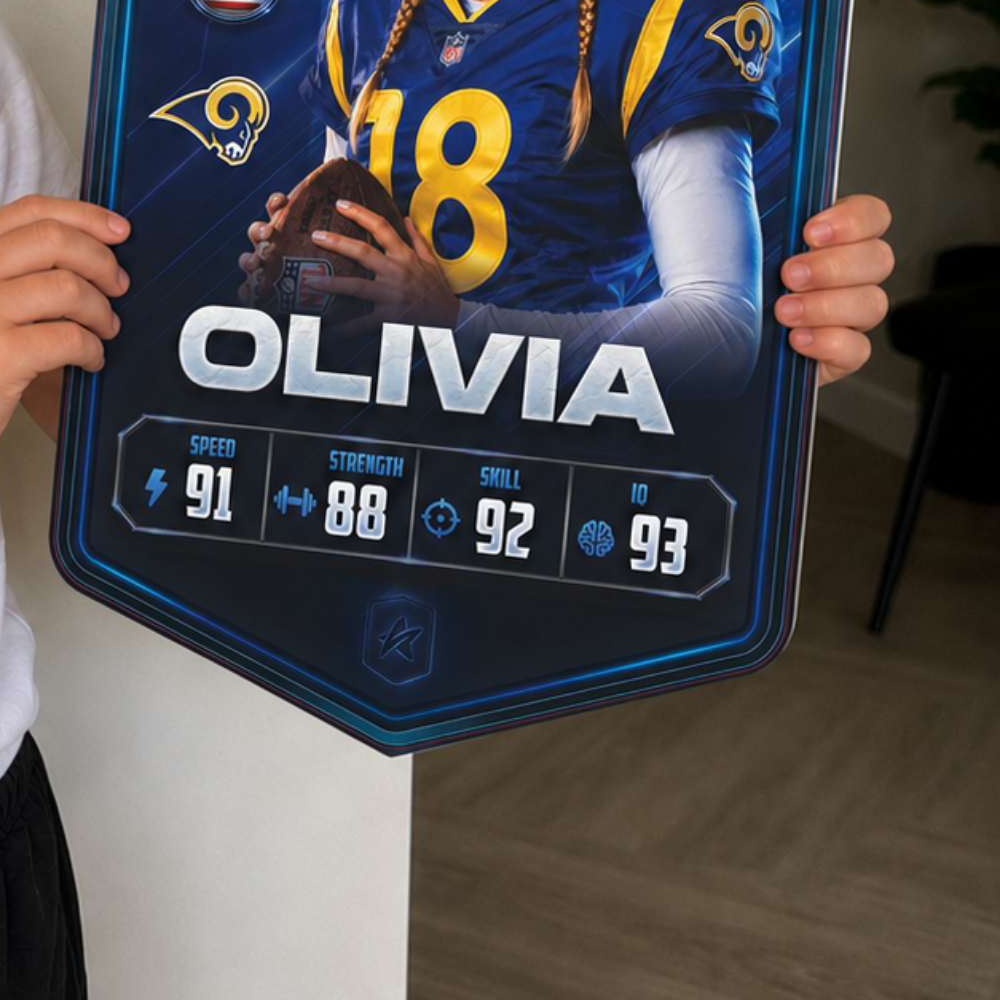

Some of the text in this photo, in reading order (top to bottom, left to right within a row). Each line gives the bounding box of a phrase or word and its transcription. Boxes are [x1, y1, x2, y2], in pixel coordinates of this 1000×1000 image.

[178, 305, 674, 435] OLIVIA
[190, 435, 236, 458] SPEED
[329, 450, 404, 477] STRENGTH
[186, 463, 233, 522] 91
[480, 466, 521, 490] SKILL
[631, 483, 648, 506] IQ
[324, 480, 388, 540] 88
[475, 498, 535, 559] 92
[630, 514, 689, 576] 93
